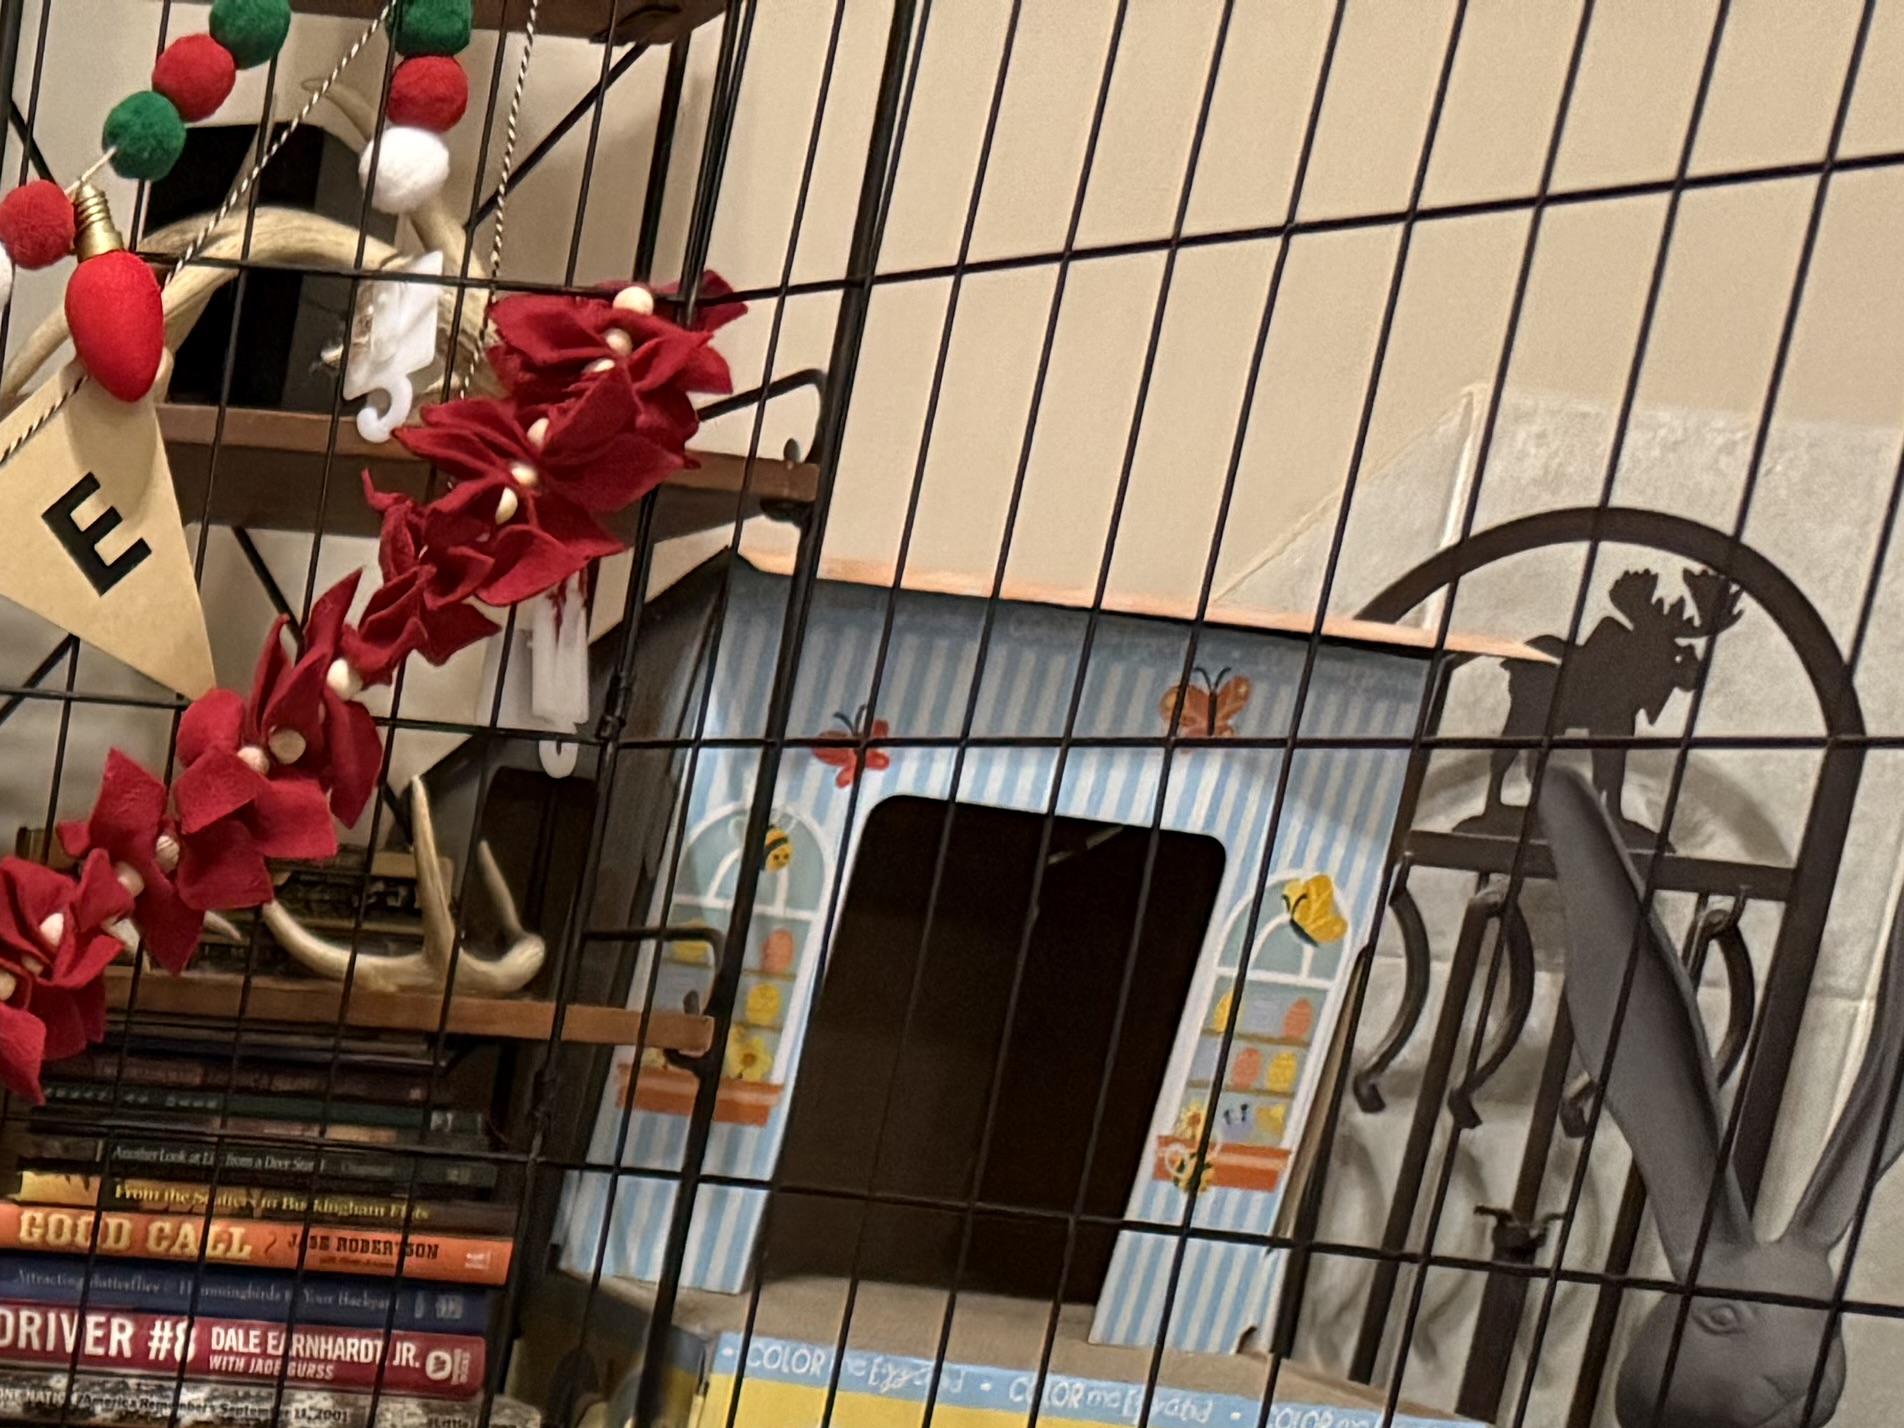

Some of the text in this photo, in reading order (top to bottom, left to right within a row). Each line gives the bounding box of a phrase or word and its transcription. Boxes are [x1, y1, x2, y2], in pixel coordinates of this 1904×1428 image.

[281, 1196, 385, 1219] Bukingham
[288, 1234, 330, 1250] JSE
[211, 1325, 261, 1353] DALE
[392, 1341, 420, 1368] JR.
[209, 1356, 335, 1381] WITH JADE GURSS
[745, 1343, 826, 1377] COLOR
[25, 1389, 77, 1405] NATIO
